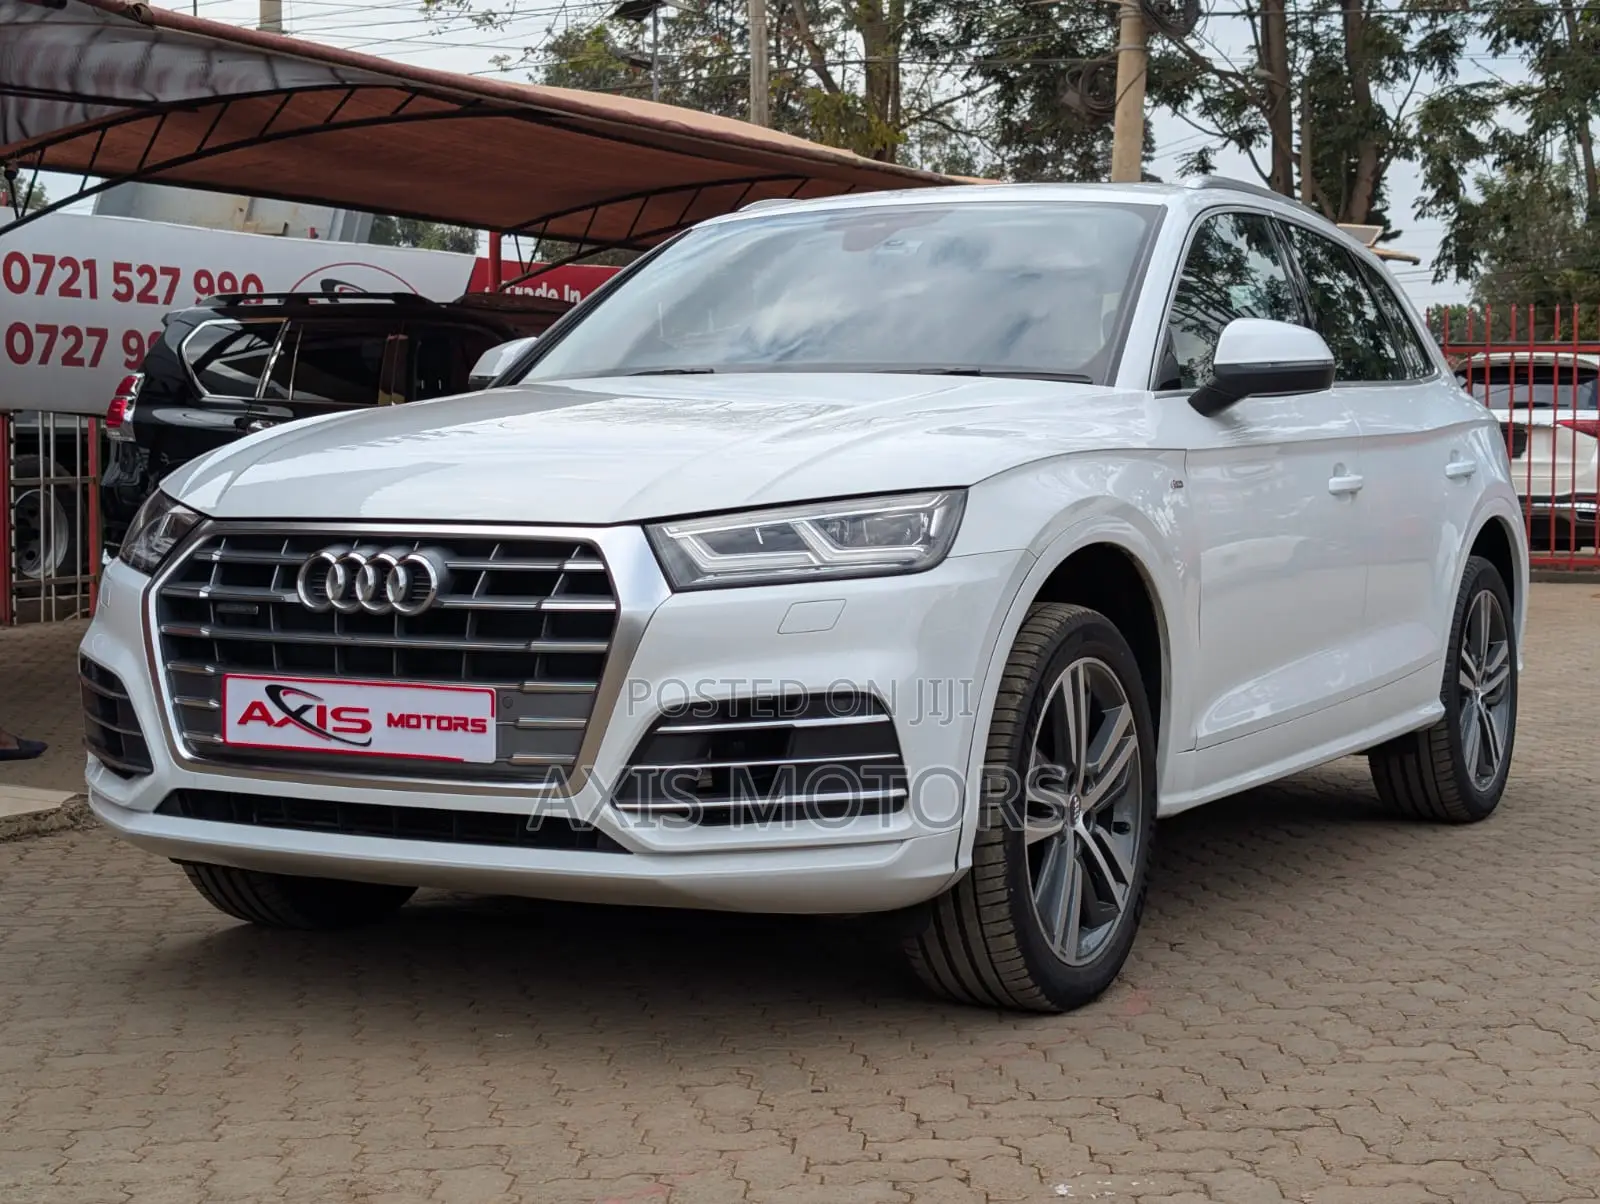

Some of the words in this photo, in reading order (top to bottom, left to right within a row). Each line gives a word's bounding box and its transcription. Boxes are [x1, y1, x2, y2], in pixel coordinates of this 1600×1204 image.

[2, 251, 98, 300] 0721
[112, 261, 181, 305] 527
[564, 284, 581, 303] In
[5, 321, 108, 368] 0727
[237, 689, 373, 743] AXIS
[386, 712, 488, 734] MOTORS
